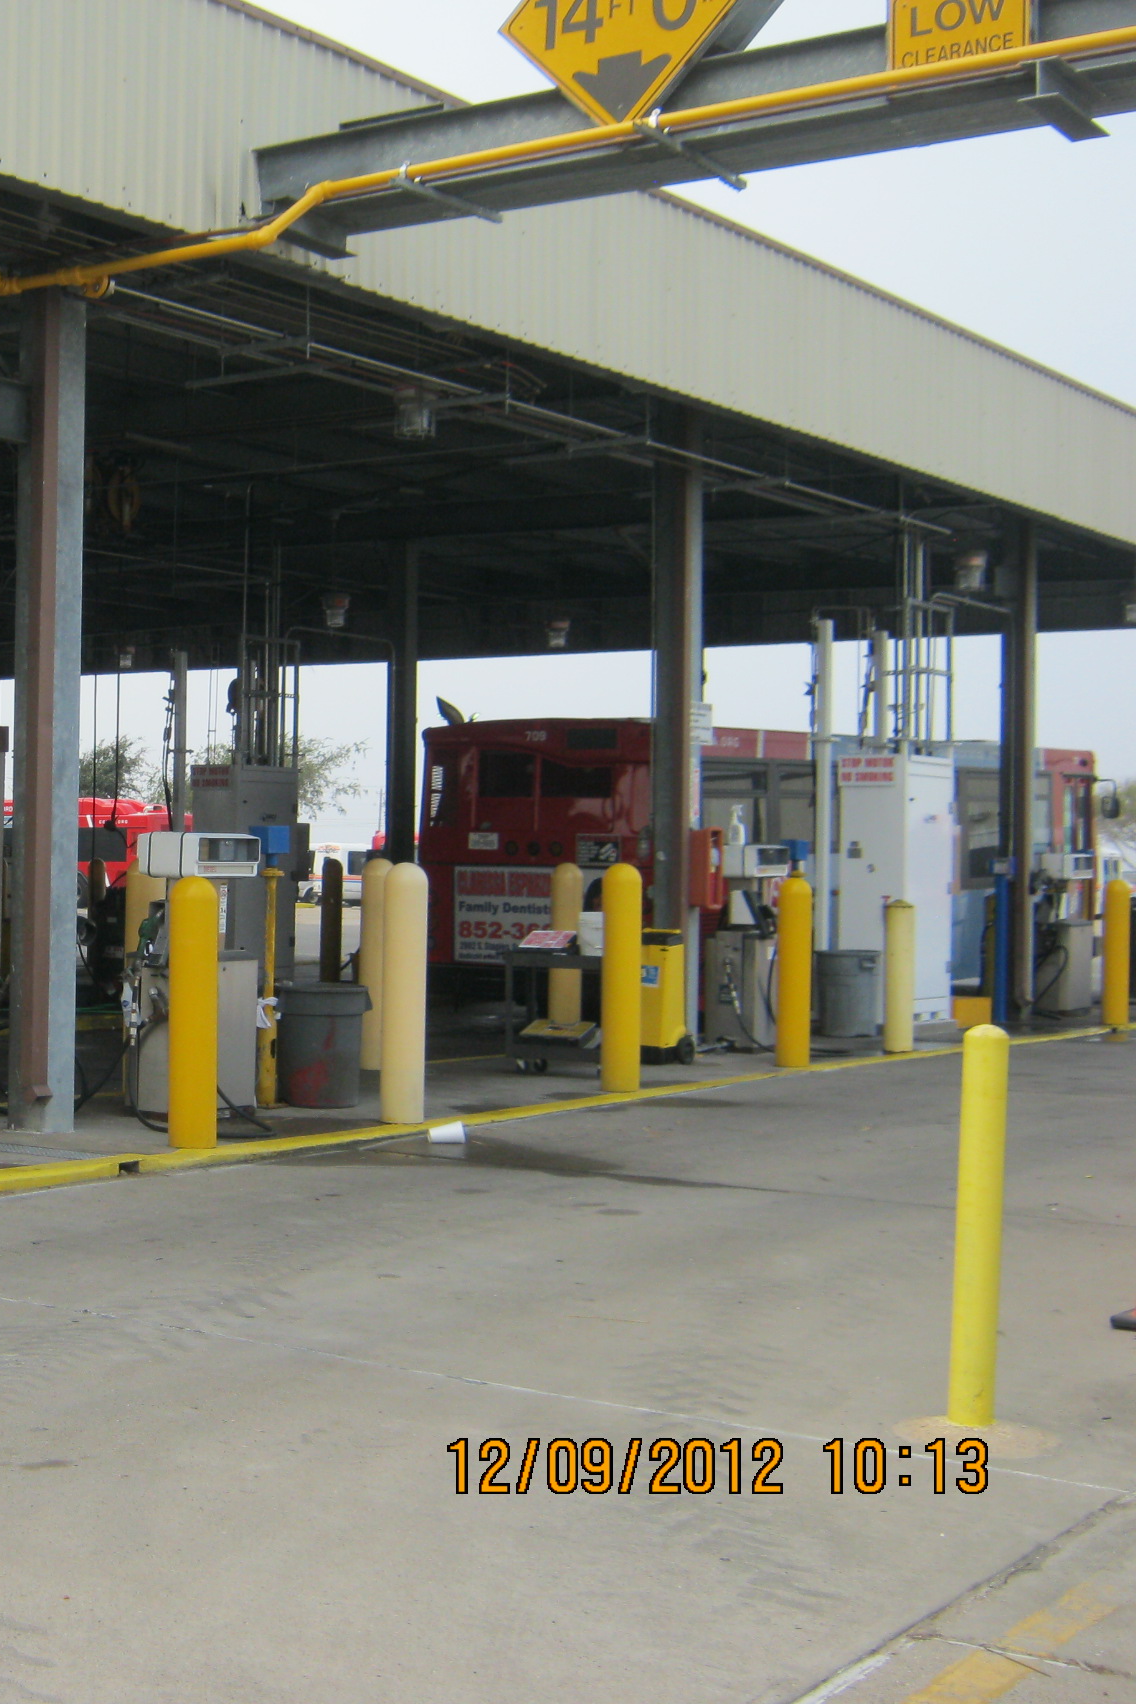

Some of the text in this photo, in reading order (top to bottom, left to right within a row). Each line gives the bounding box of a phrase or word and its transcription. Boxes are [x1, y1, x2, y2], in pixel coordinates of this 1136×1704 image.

[534, 0, 604, 50] 14
[909, 0, 1005, 37] LOW
[901, 32, 1014, 68] CLEARANCE
[458, 901, 499, 915] Family
